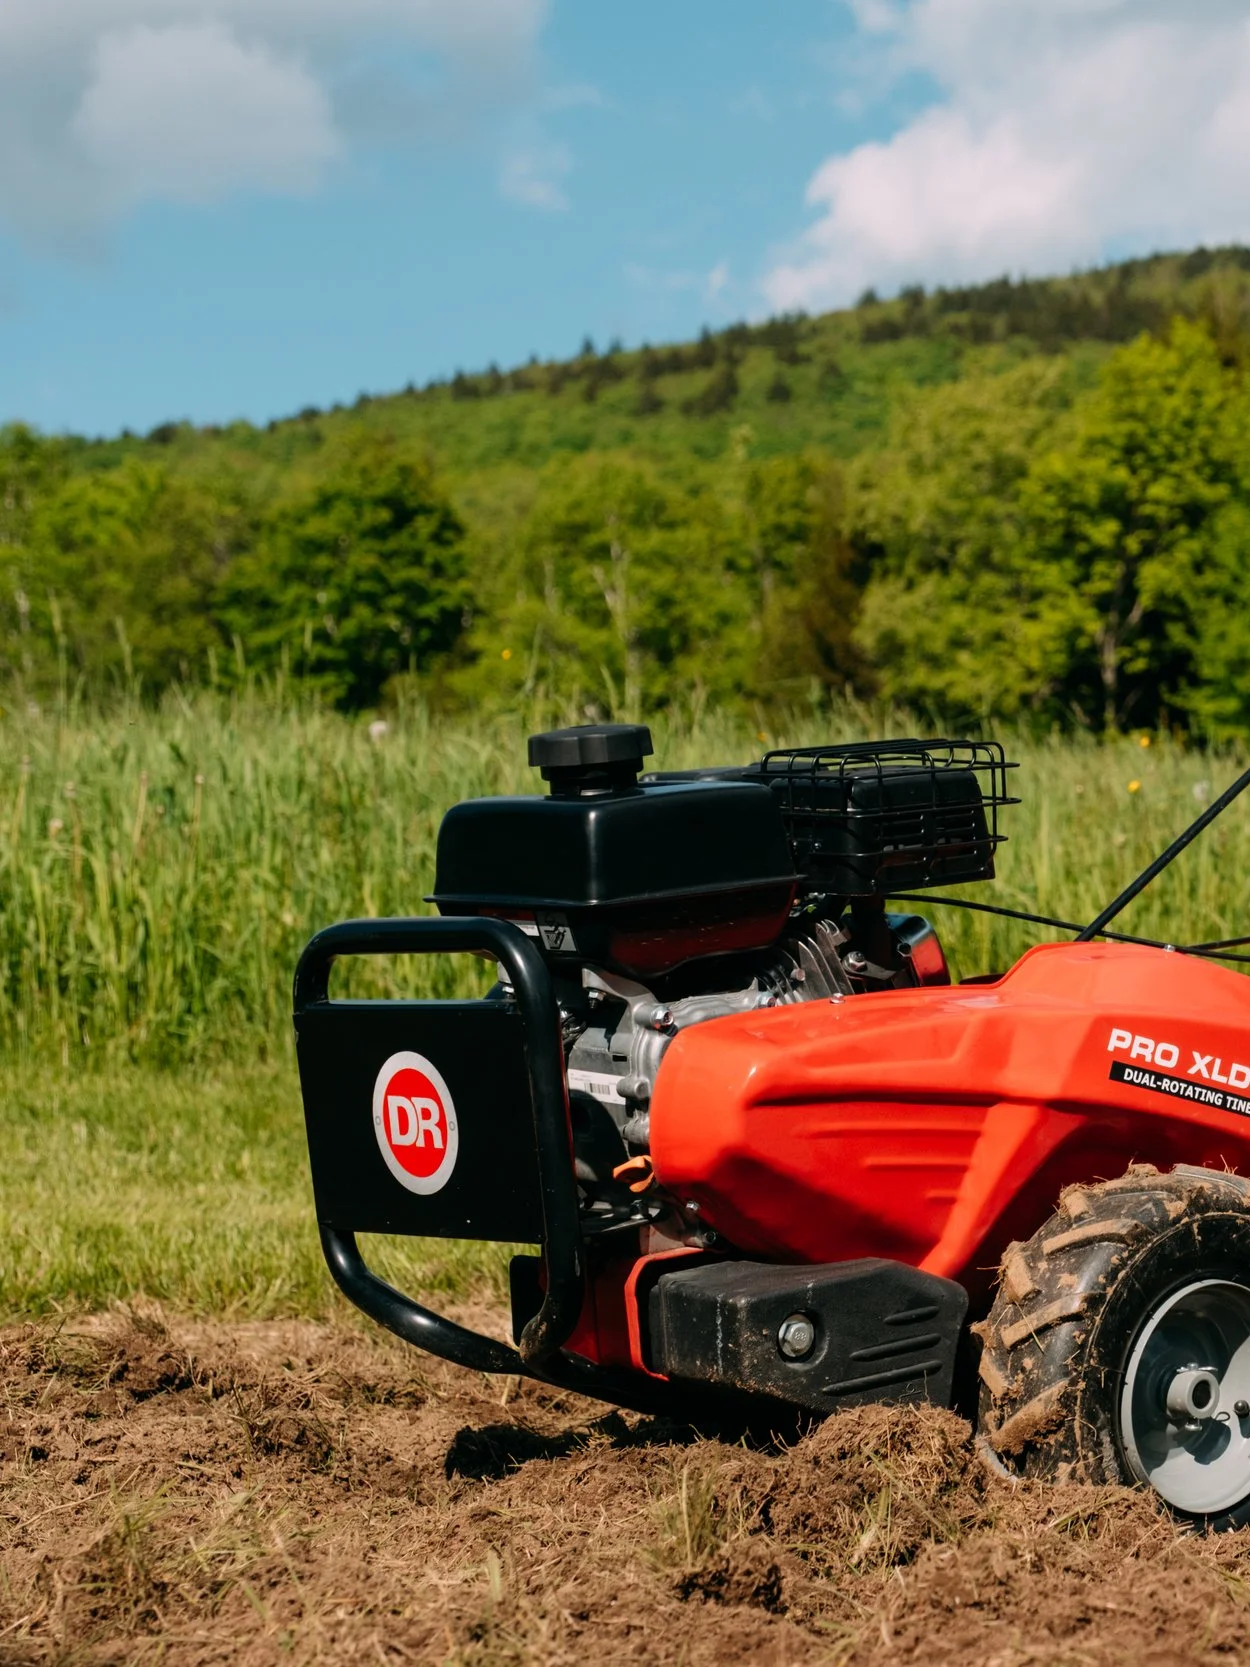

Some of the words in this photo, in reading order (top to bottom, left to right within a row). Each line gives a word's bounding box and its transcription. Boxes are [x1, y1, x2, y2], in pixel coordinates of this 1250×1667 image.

[1107, 1028, 1180, 1069] PRO
[1123, 1068, 1223, 1105] DUAL-ROTATING
[387, 1095, 444, 1149] DR
